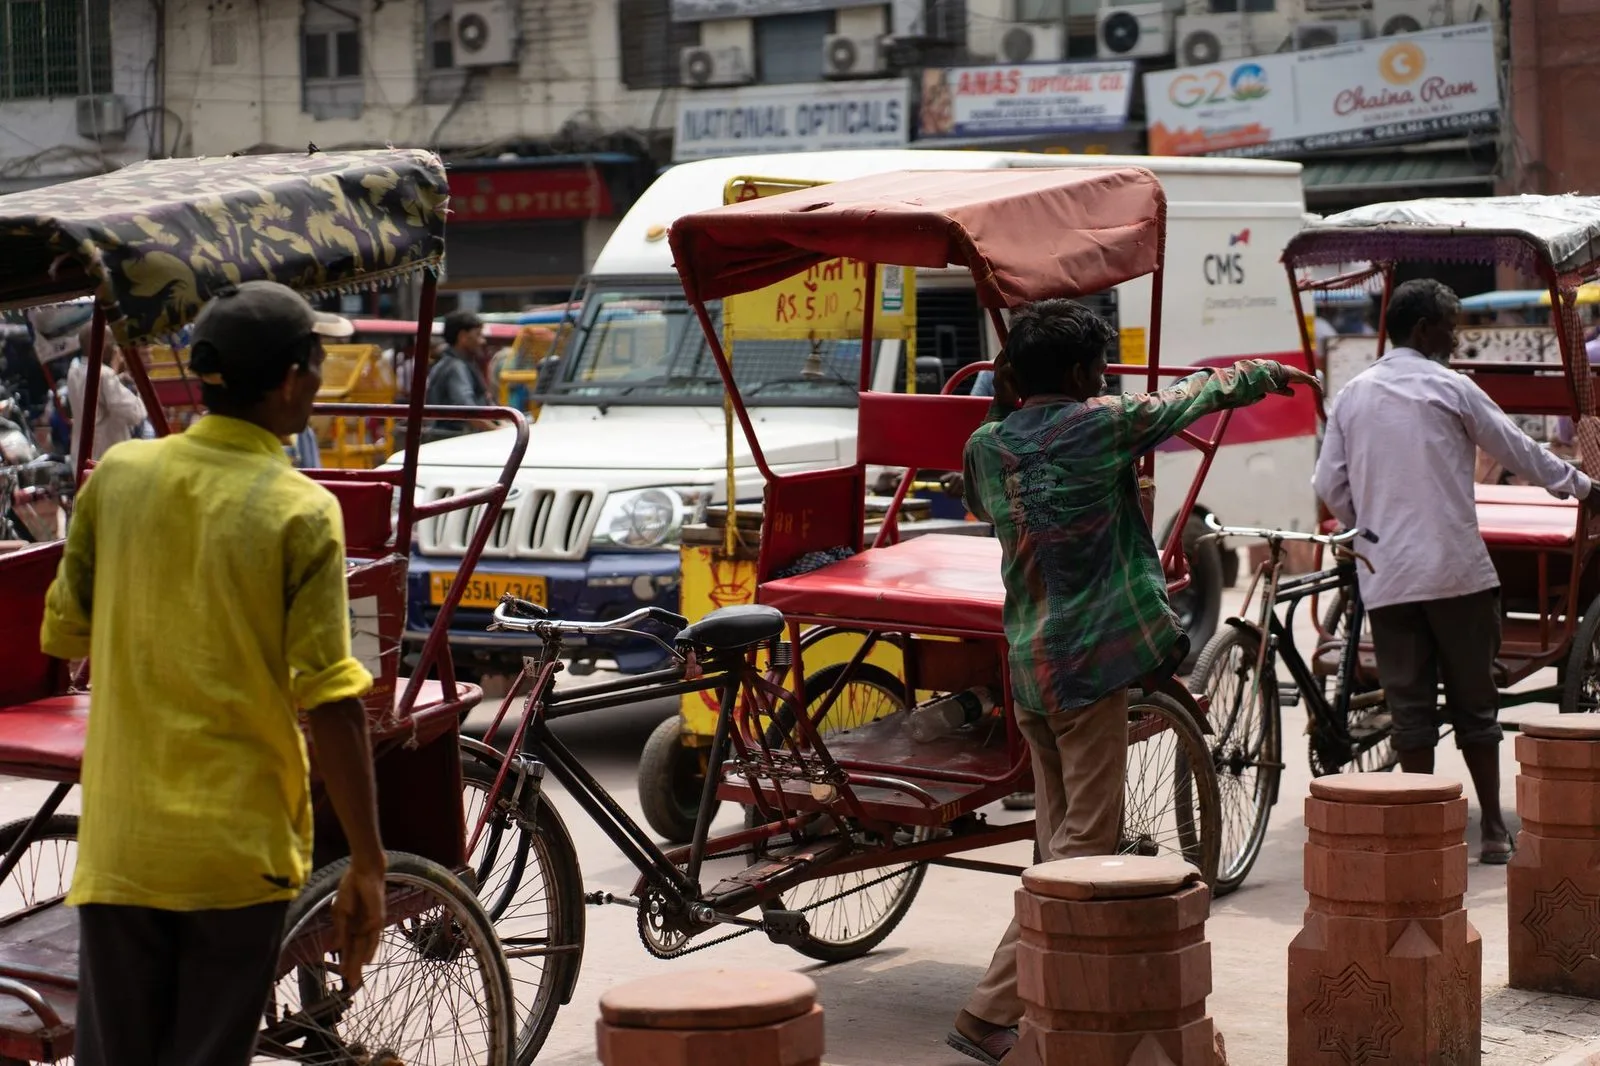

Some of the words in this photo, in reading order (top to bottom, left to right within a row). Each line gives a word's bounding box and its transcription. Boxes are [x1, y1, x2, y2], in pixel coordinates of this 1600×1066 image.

[1028, 76, 1093, 93] OPTICAL
[1333, 85, 1414, 116] Chaina
[1420, 76, 1478, 102] Ram
[682, 105, 788, 141] NATIONAL
[795, 98, 900, 135] OPTICALS
[1203, 254, 1244, 285] CMS
[441, 577, 543, 604] H55AL4343
